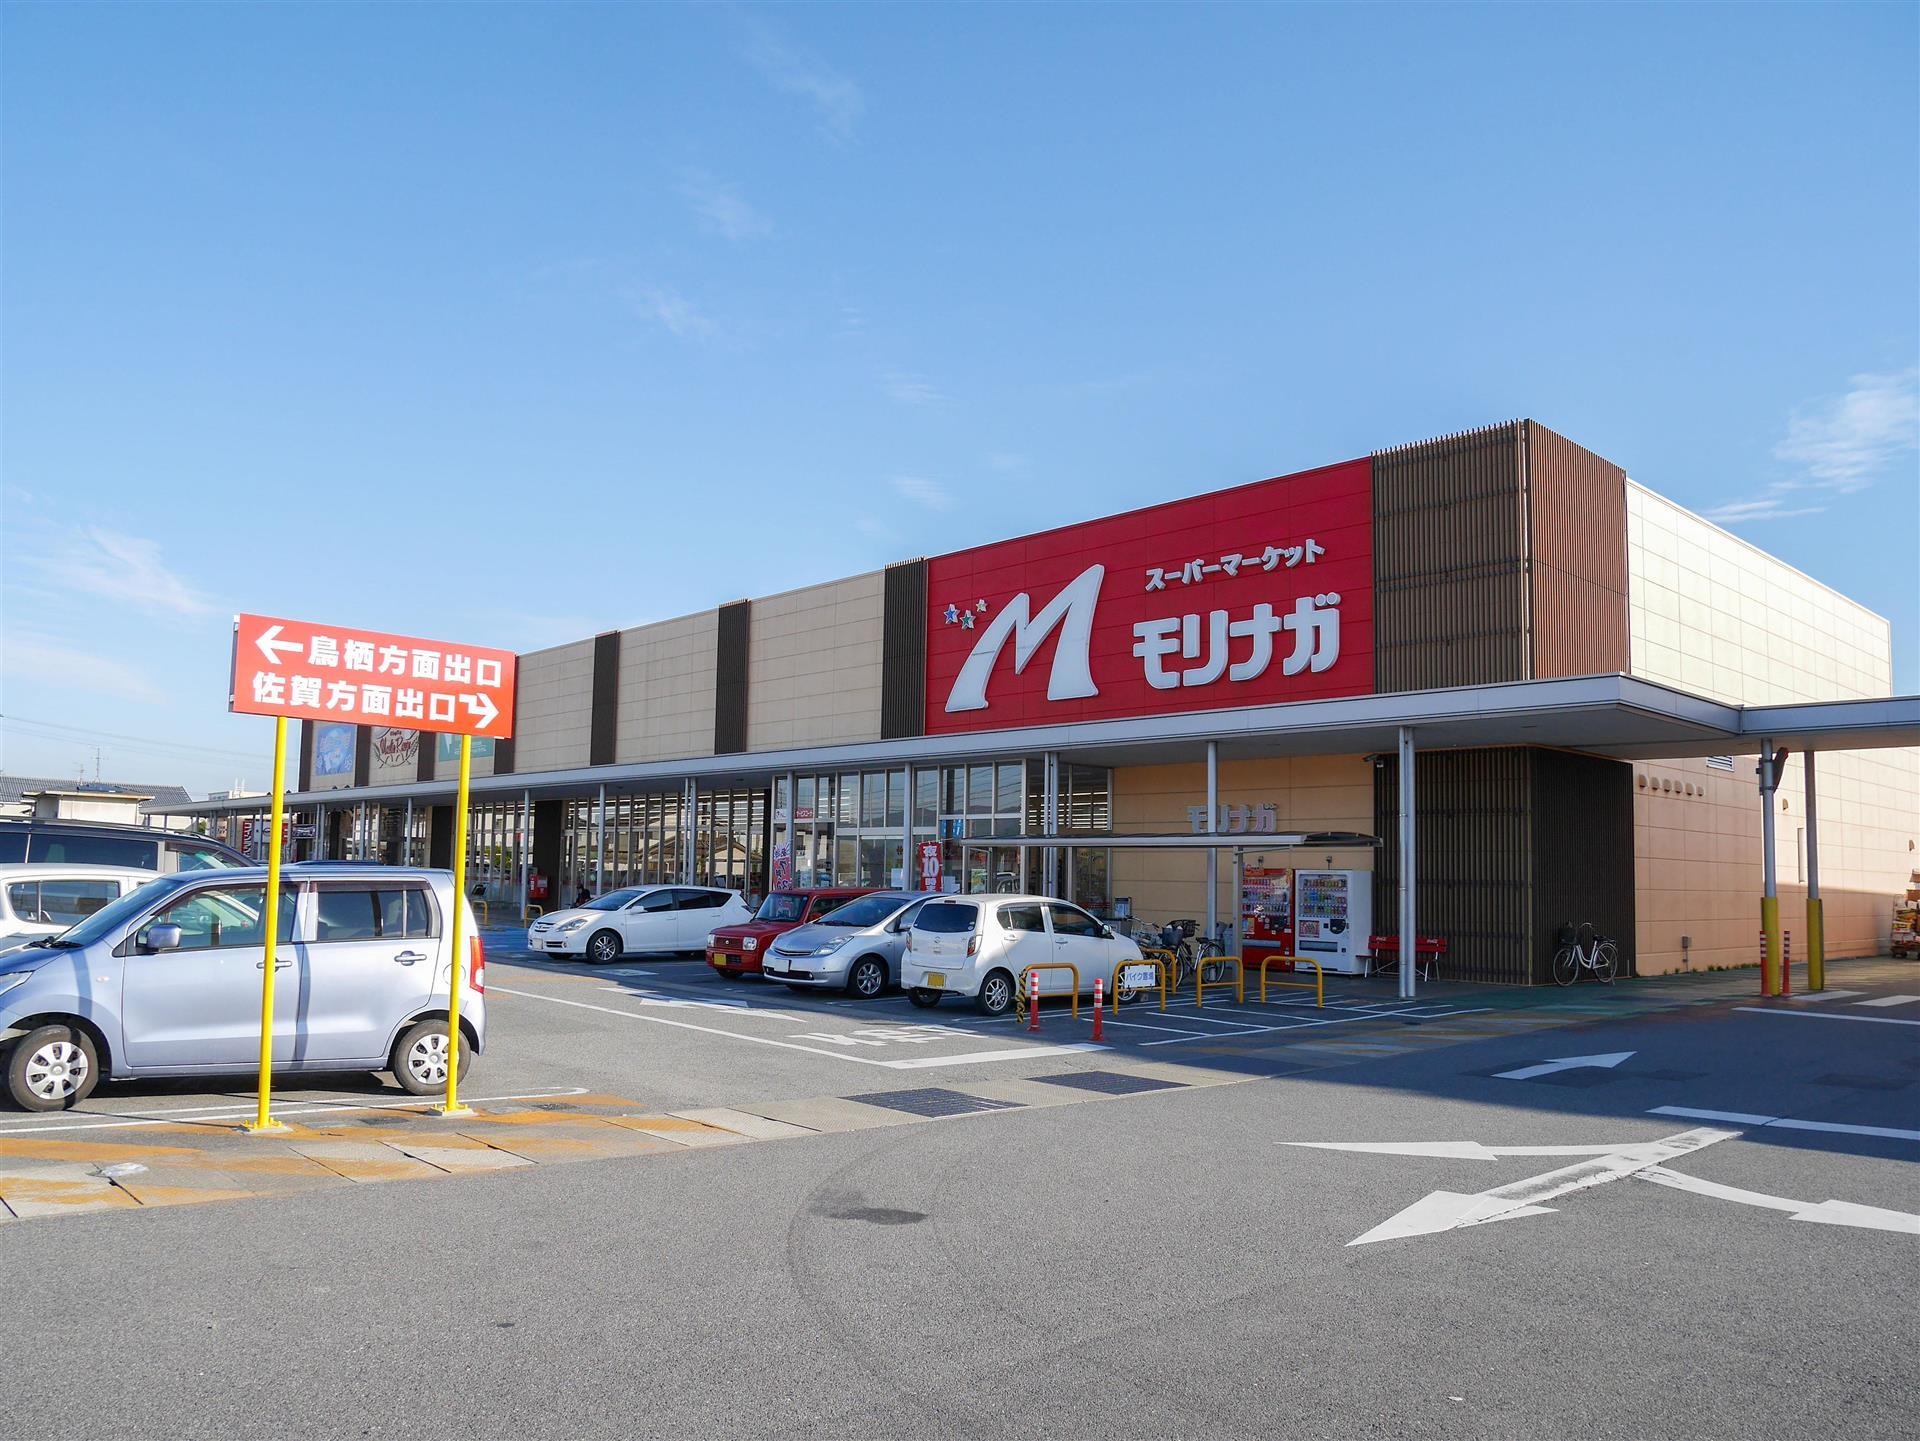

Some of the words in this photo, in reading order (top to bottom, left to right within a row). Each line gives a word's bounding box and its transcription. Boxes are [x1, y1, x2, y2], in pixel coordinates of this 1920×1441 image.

[1145, 538, 1325, 592] スーパーマーケット
[308, 635, 502, 688] 鳥栖方面出口
[1133, 592, 1341, 690] モリナガ
[252, 672, 456, 723] 佐賀方面出口
